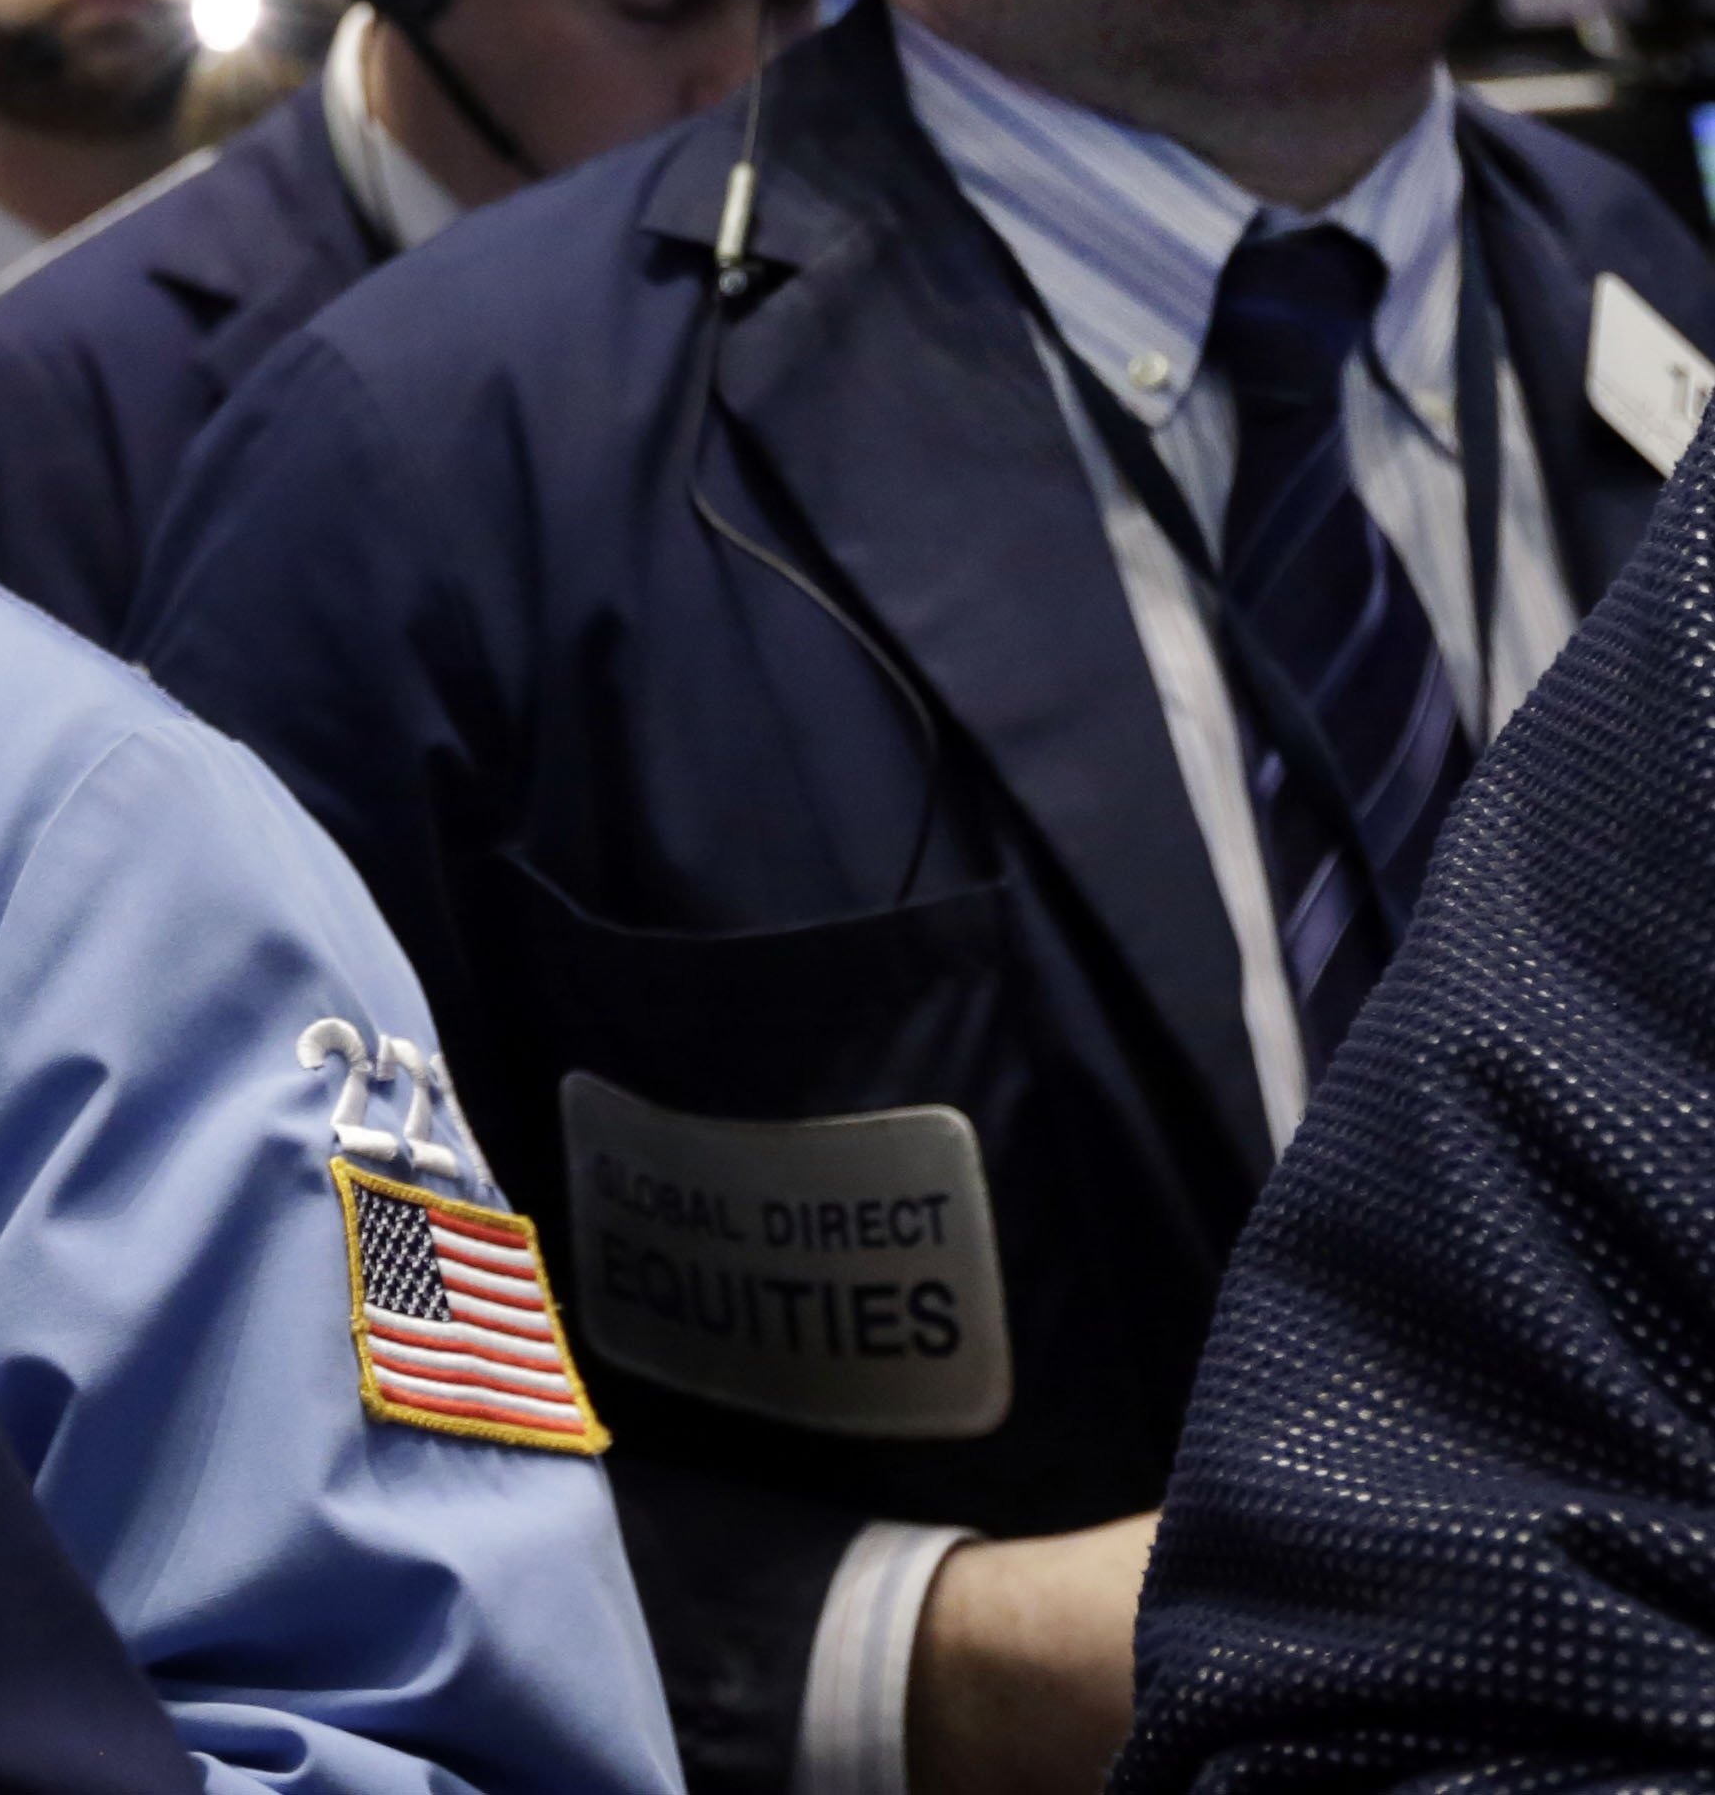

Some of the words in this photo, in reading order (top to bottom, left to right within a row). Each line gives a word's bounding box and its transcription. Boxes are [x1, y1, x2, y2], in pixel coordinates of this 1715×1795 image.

[589, 1149, 747, 1246] GLOBAL
[762, 1192, 951, 1255] DIRECT
[599, 1228, 963, 1361] EQUITIES
